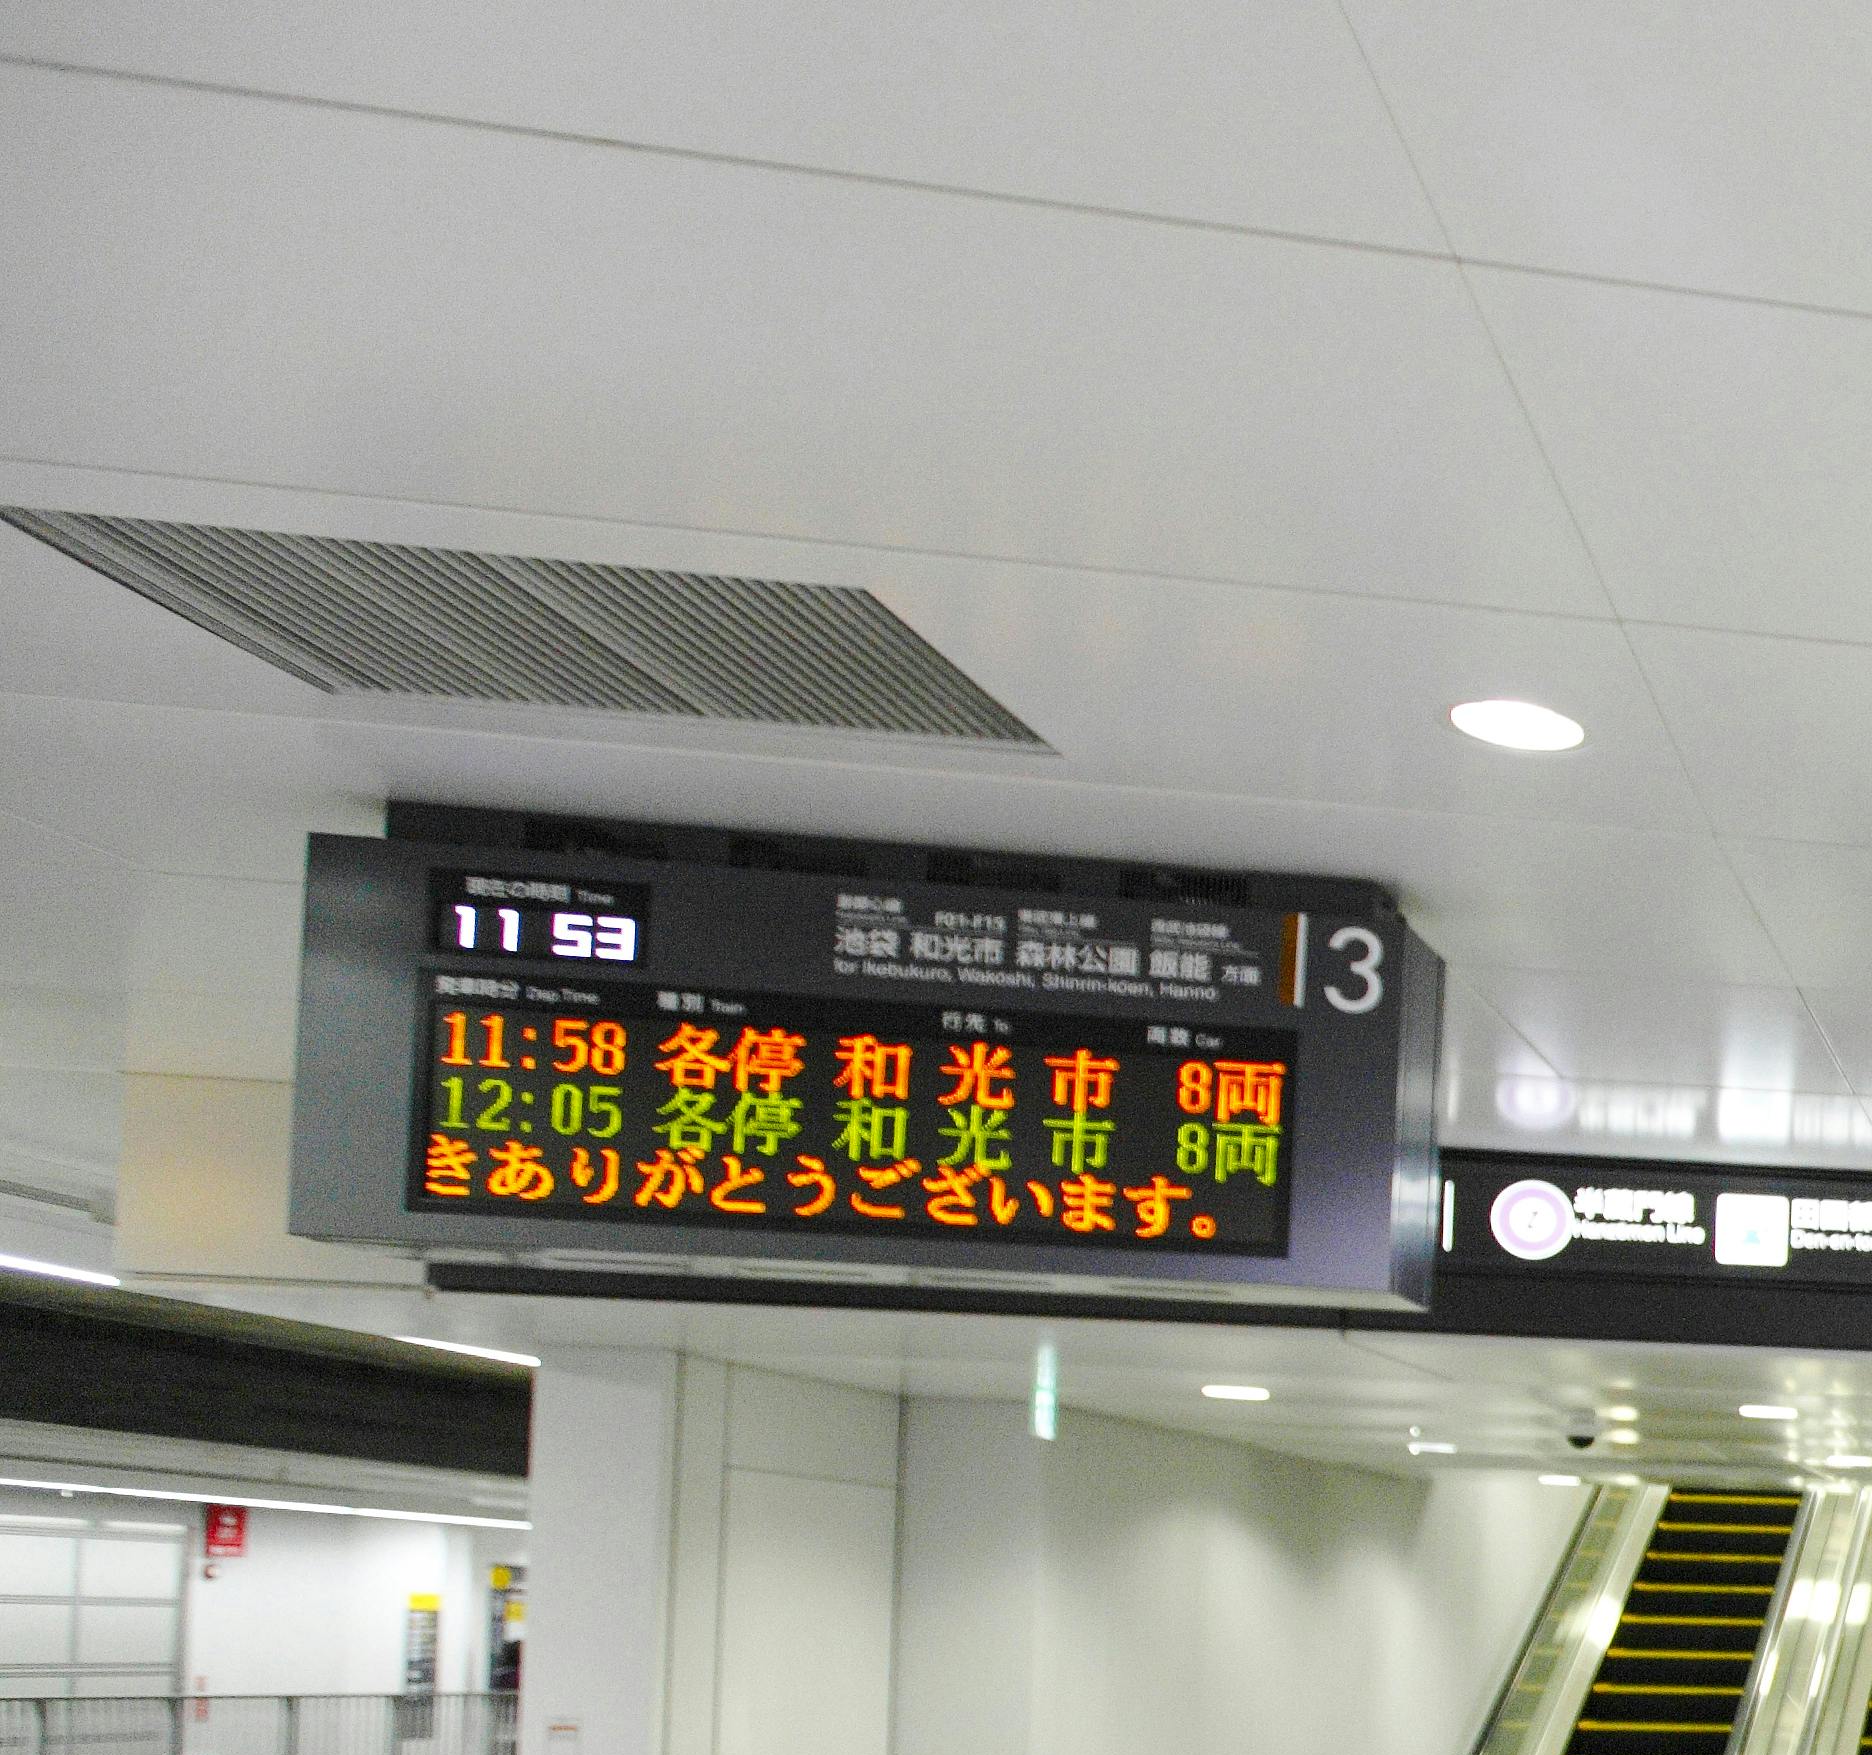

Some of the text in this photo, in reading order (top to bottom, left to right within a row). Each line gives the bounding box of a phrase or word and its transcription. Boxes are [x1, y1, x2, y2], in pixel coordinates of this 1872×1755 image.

[454, 904, 638, 961] 11 53
[834, 926, 901, 958] 池袋
[910, 931, 1005, 965] 和光市
[1016, 940, 1139, 976] 森林公園
[1149, 949, 1212, 983] 飯能
[1221, 964, 1262, 987] 方面
[1324, 925, 1383, 1014] 3
[834, 958, 859, 975] for
[862, 960, 953, 983] Ikebukuro,
[942, 1010, 988, 1033] 行先
[440, 1010, 628, 1076] 11:58
[654, 1022, 805, 1092] 各停
[1176, 1058, 1288, 1129] 8両
[437, 1075, 625, 1141] 12:05
[653, 1087, 805, 1155] 各停
[1175, 1120, 1280, 1188] 8両
[425, 1131, 1219, 1242] きありがとうございます。
